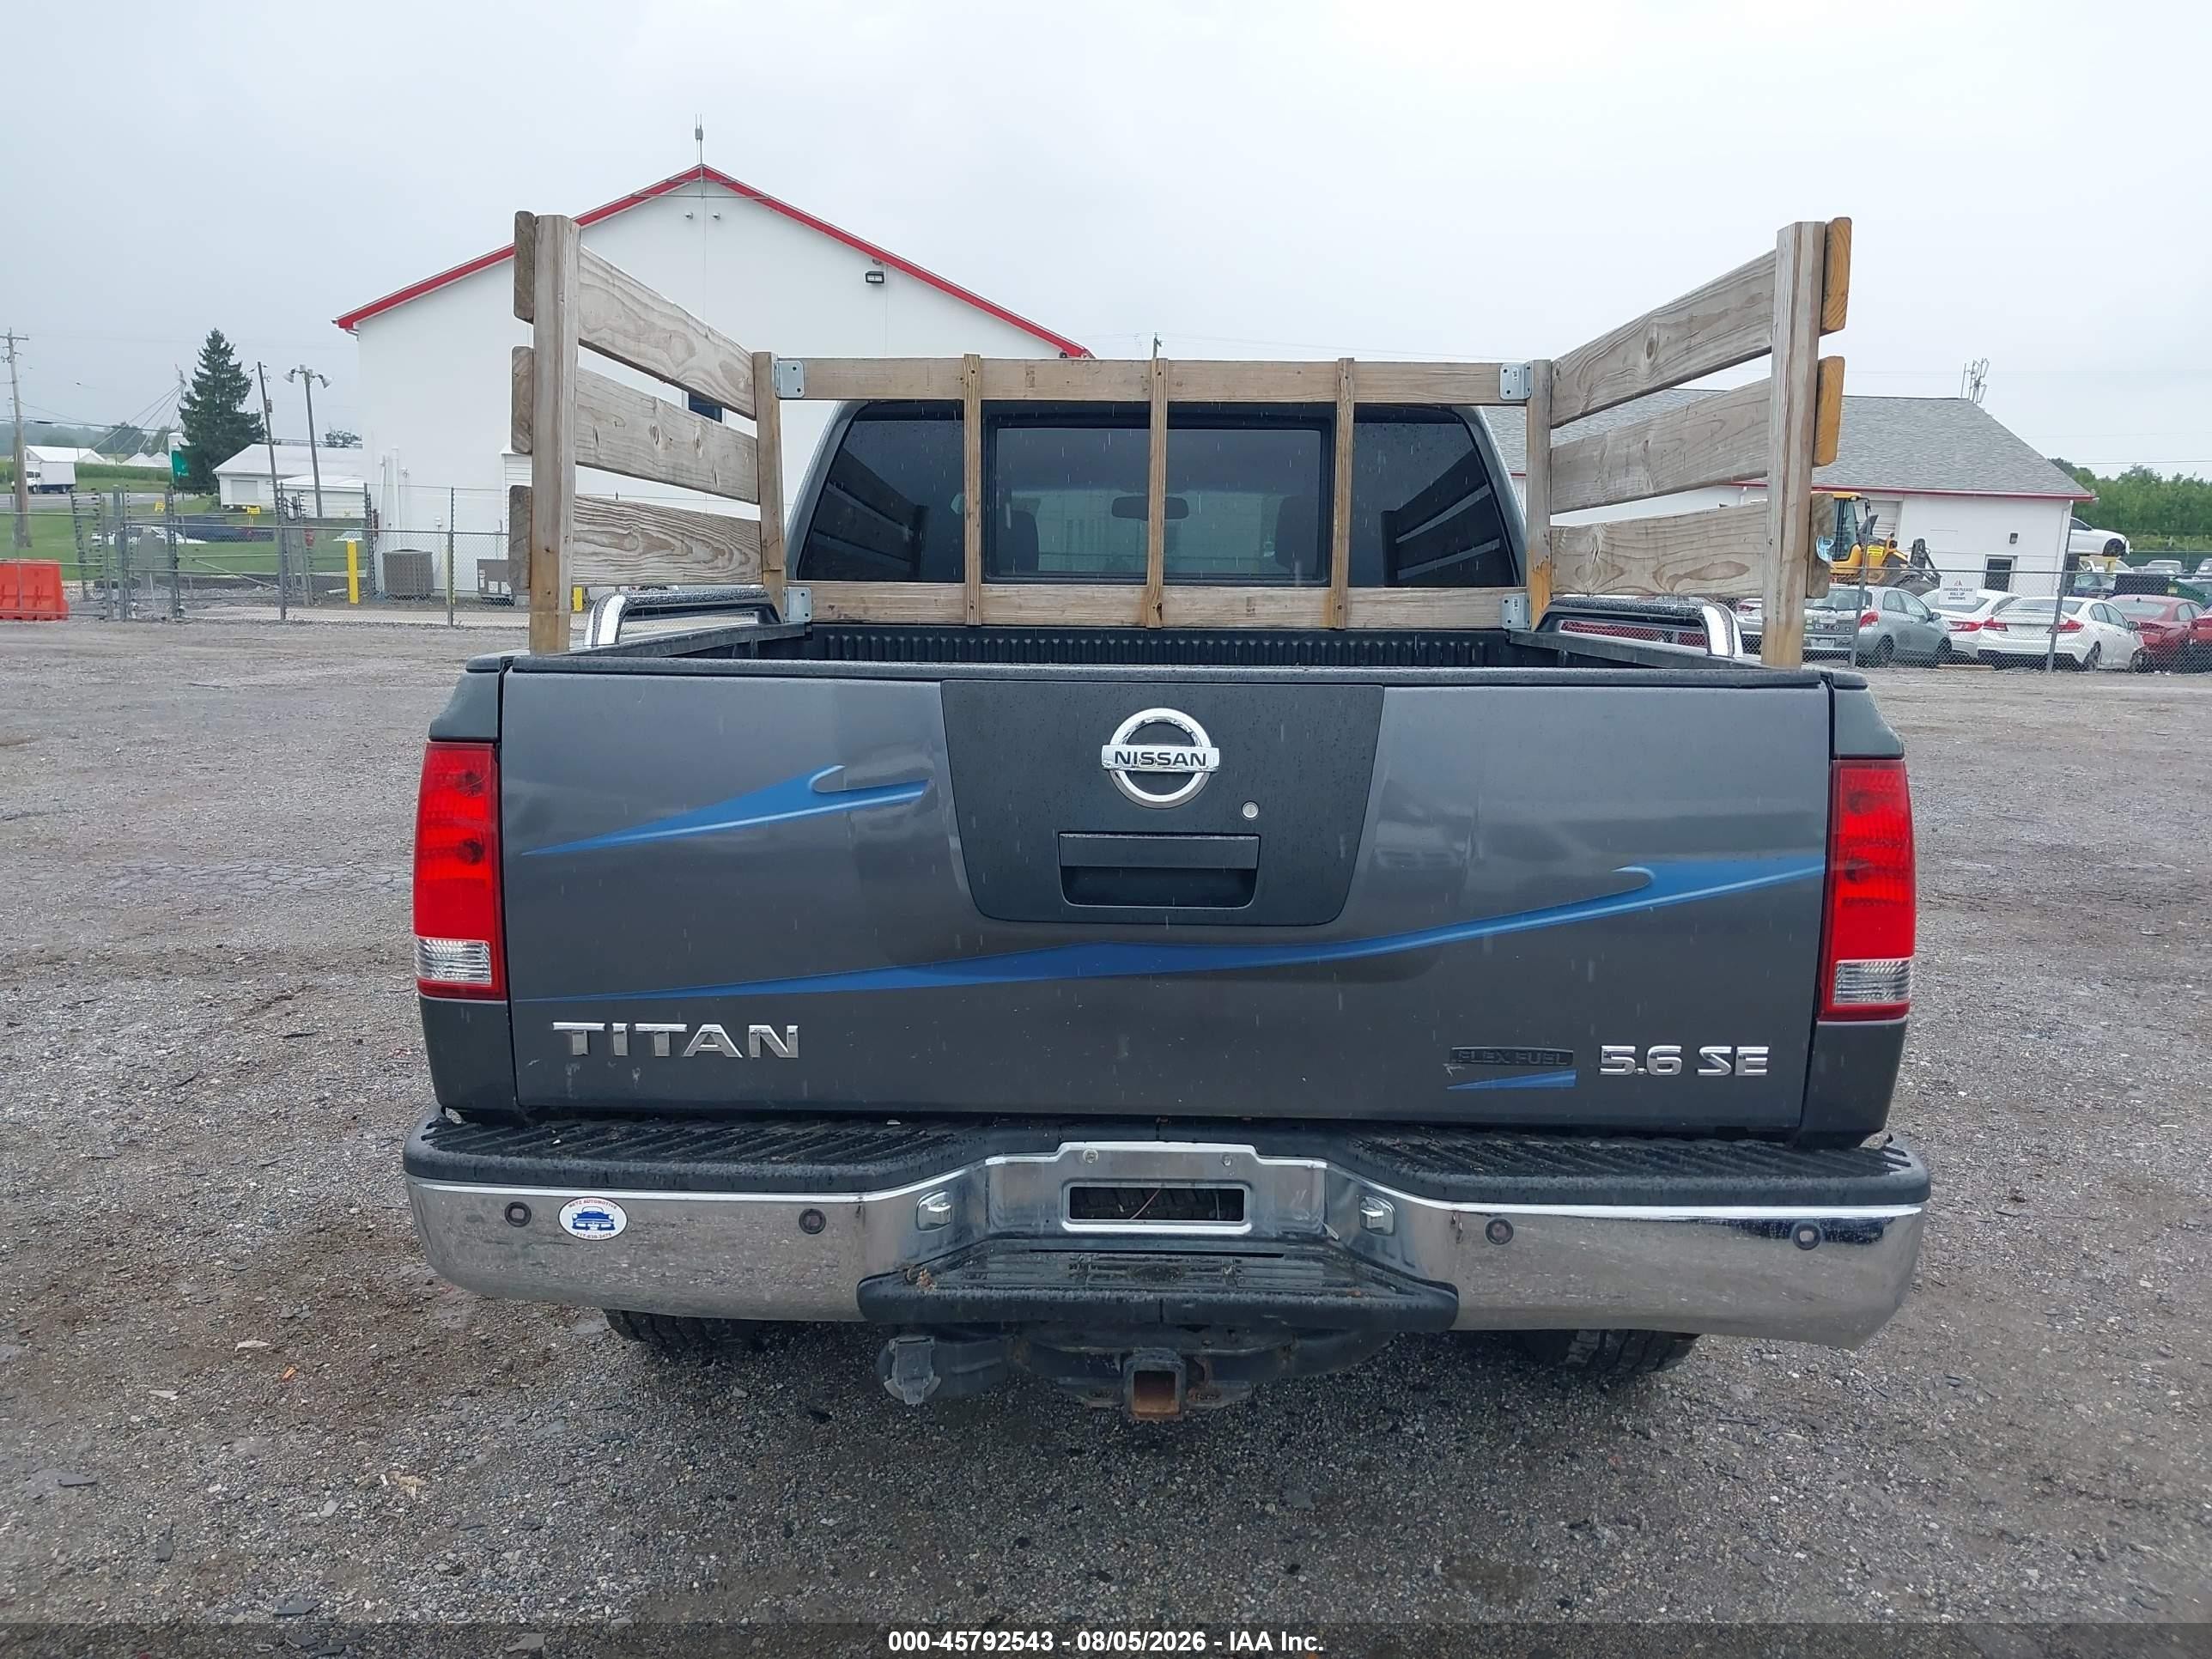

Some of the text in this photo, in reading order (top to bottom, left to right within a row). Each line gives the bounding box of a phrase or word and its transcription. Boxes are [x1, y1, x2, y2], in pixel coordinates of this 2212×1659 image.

[1115, 750, 1206, 767] NISSAN
[552, 1022, 799, 1058] TITAN
[1457, 1049, 1567, 1065] FLEX FUEL
[1600, 1045, 1769, 1076] 5.6 SE
[583, 1199, 617, 1209] AUTOMOTIVE
